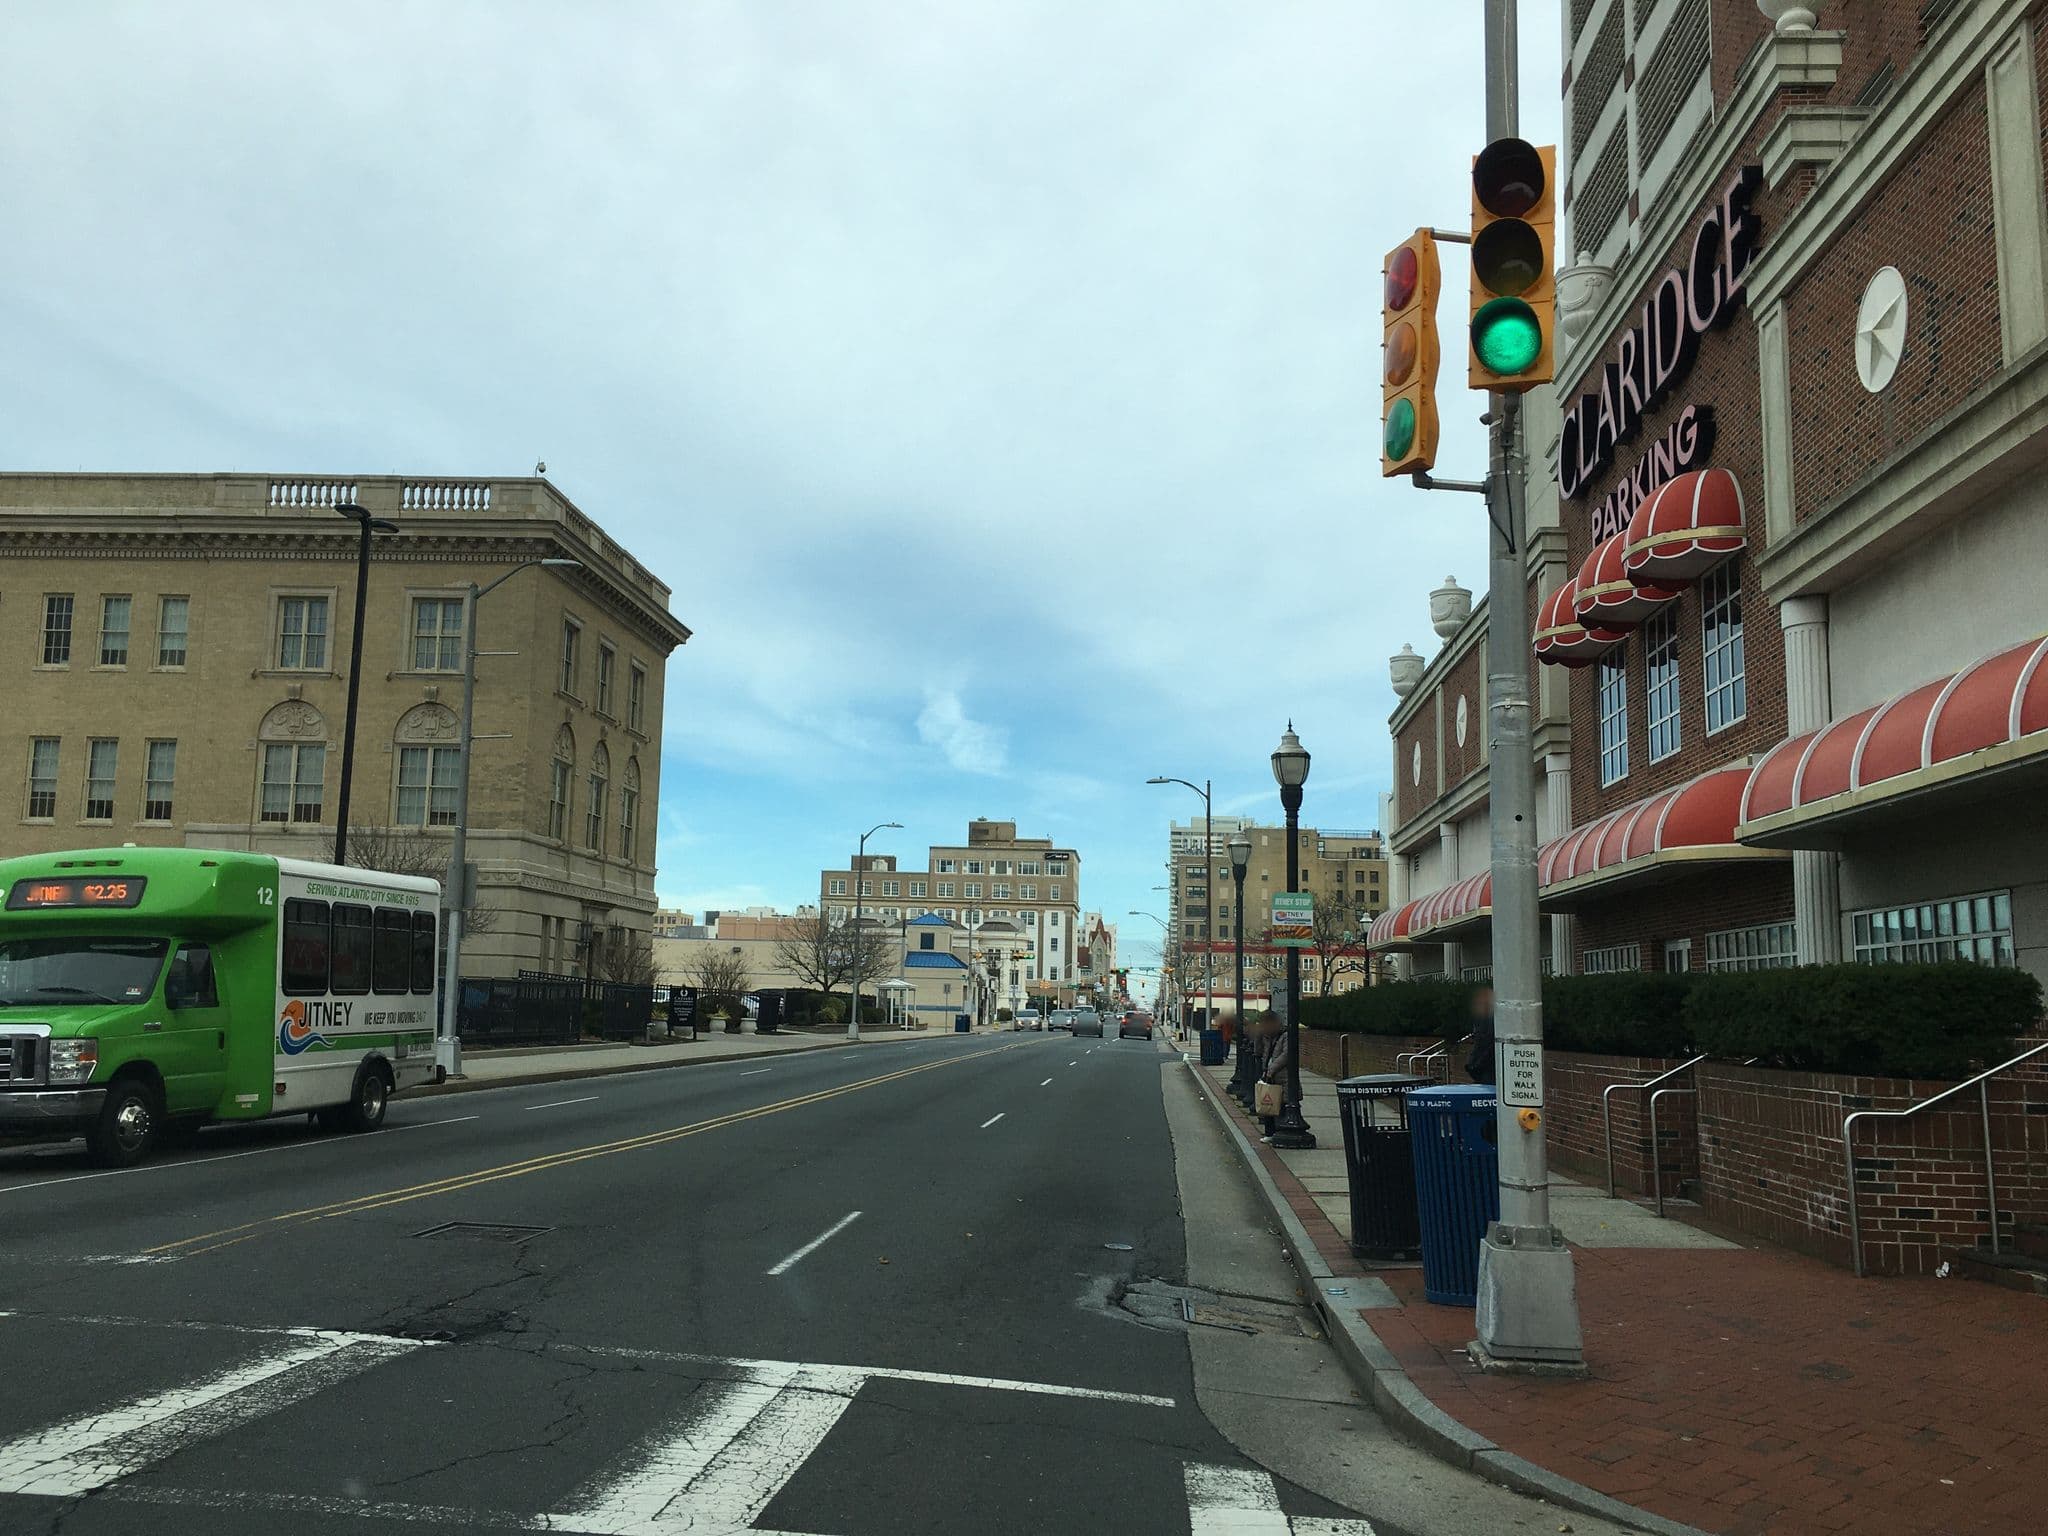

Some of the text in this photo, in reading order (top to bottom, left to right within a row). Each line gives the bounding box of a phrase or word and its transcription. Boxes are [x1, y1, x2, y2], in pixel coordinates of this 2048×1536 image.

[1557, 168, 1757, 501] CLARIDGE
[1591, 404, 1704, 549] PARKING
[257, 886, 273, 905] 12
[306, 882, 420, 906] SERVING ATLANTIC CITY SINCE 1915
[299, 1001, 353, 1028] JITNEY
[1514, 1050, 1535, 1058] PUSH
[1509, 1060, 1539, 1068] BUTTON
[1517, 1070, 1533, 1078] FOR
[1514, 1081, 1536, 1089] WALK
[1511, 1091, 1539, 1099] SIGNAL
